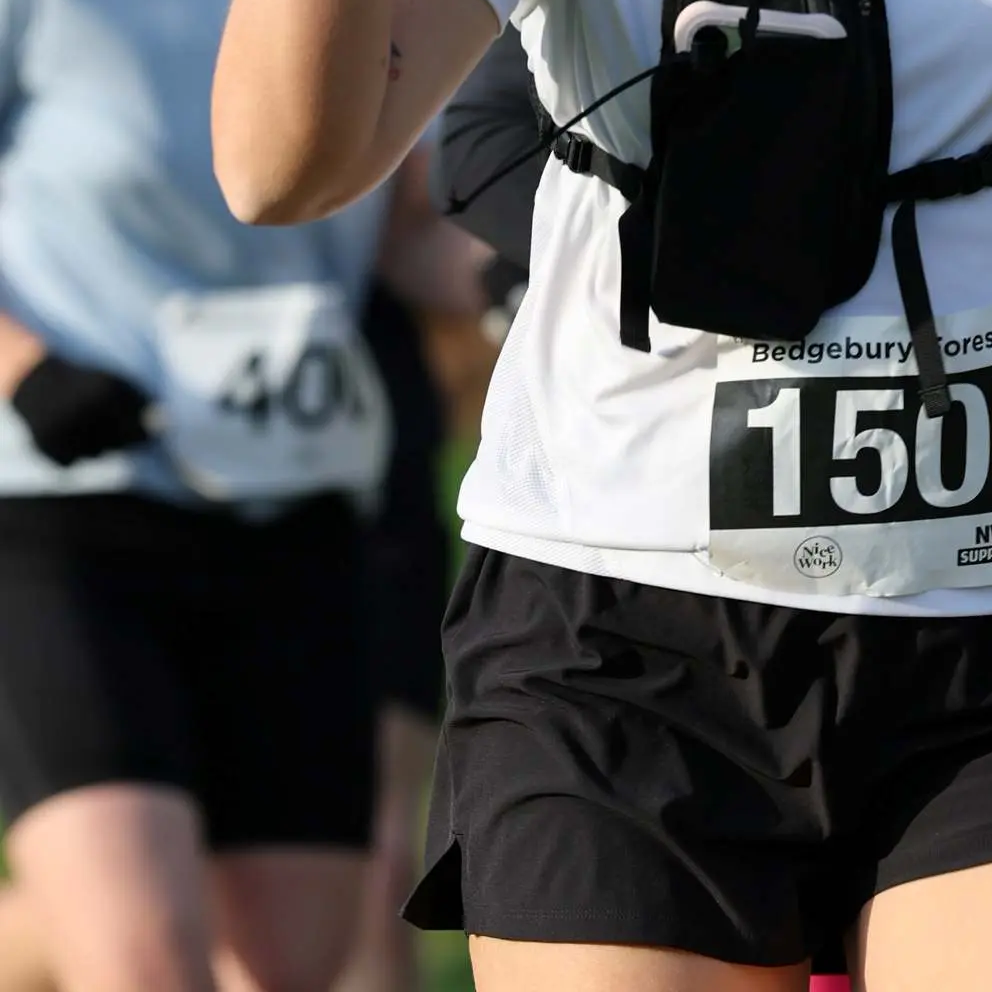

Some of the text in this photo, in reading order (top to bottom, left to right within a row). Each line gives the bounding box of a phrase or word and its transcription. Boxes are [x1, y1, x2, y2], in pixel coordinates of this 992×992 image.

[752, 336, 912, 364] Bedgebury
[801, 542, 835, 558] Nice
[798, 554, 837, 569] Work
